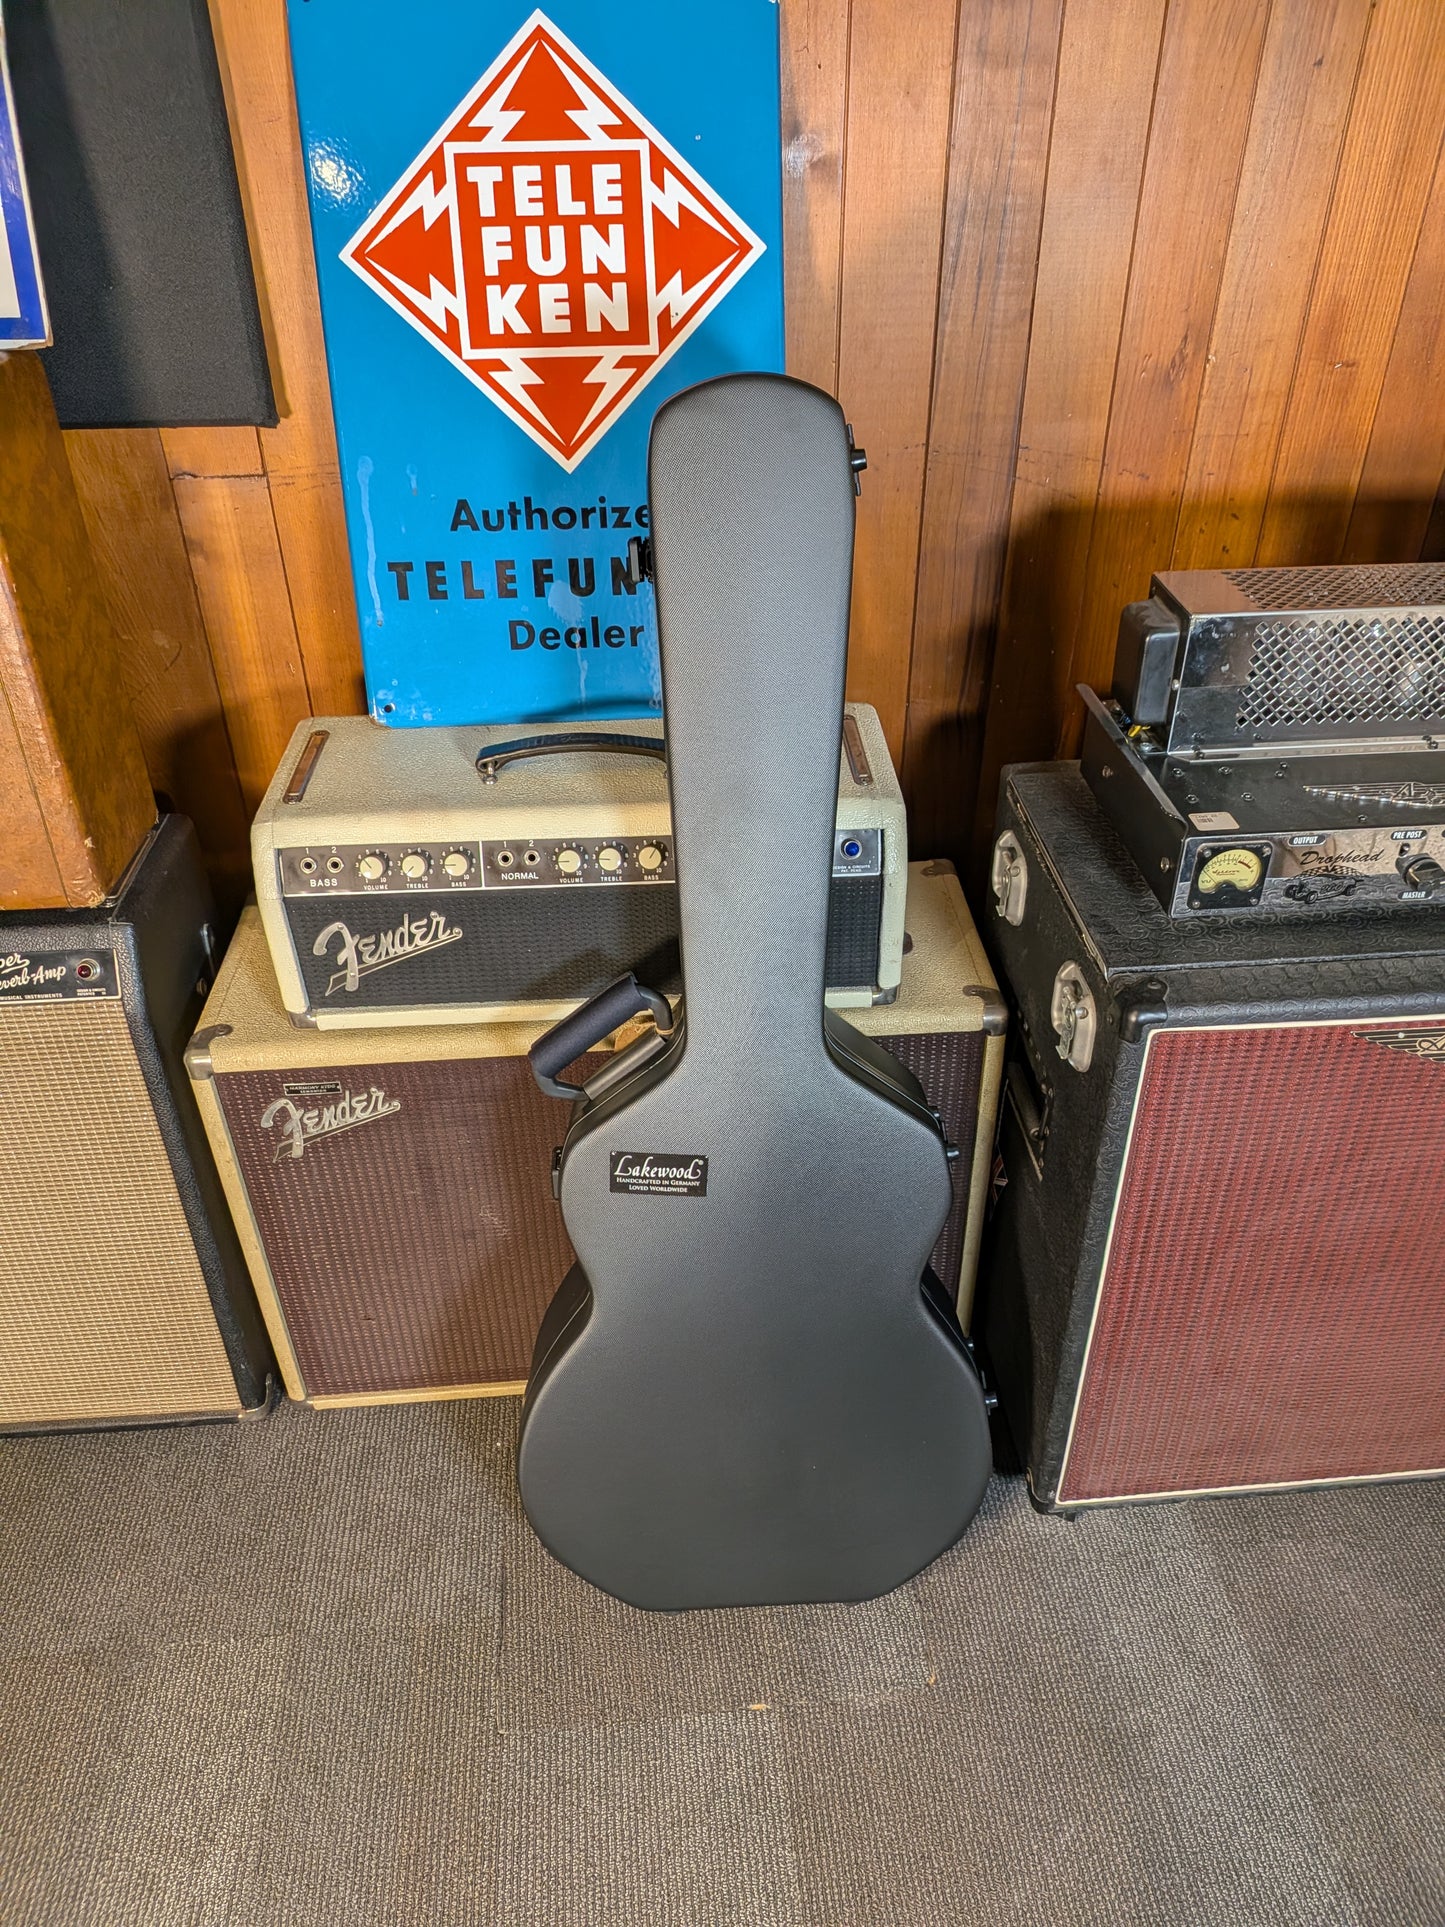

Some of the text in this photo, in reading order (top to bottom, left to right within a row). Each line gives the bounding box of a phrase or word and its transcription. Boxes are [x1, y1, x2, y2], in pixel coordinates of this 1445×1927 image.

[466, 163, 623, 217] TELE
[481, 224, 626, 277] FUN
[485, 281, 630, 335] KEN
[450, 496, 649, 531] Authorize
[387, 557, 637, 600] TELEFUN
[508, 616, 644, 650] Dealer
[1293, 836, 1318, 845] OUTPUT
[1393, 830, 1423, 839] PRE POST
[331, 846, 337, 854] 2
[1300, 849, 1385, 866] Drophead
[309, 878, 338, 887] BASS
[501, 871, 539, 881] NORMAL
[1401, 891, 1426, 899] MASTER
[313, 911, 463, 996] Fender
[261, 1086, 400, 1163] Fender
[614, 1155, 702, 1180] Lakewood
[616, 1177, 661, 1185] HANDCRAFTED
[670, 1179, 701, 1187] GERMANY
